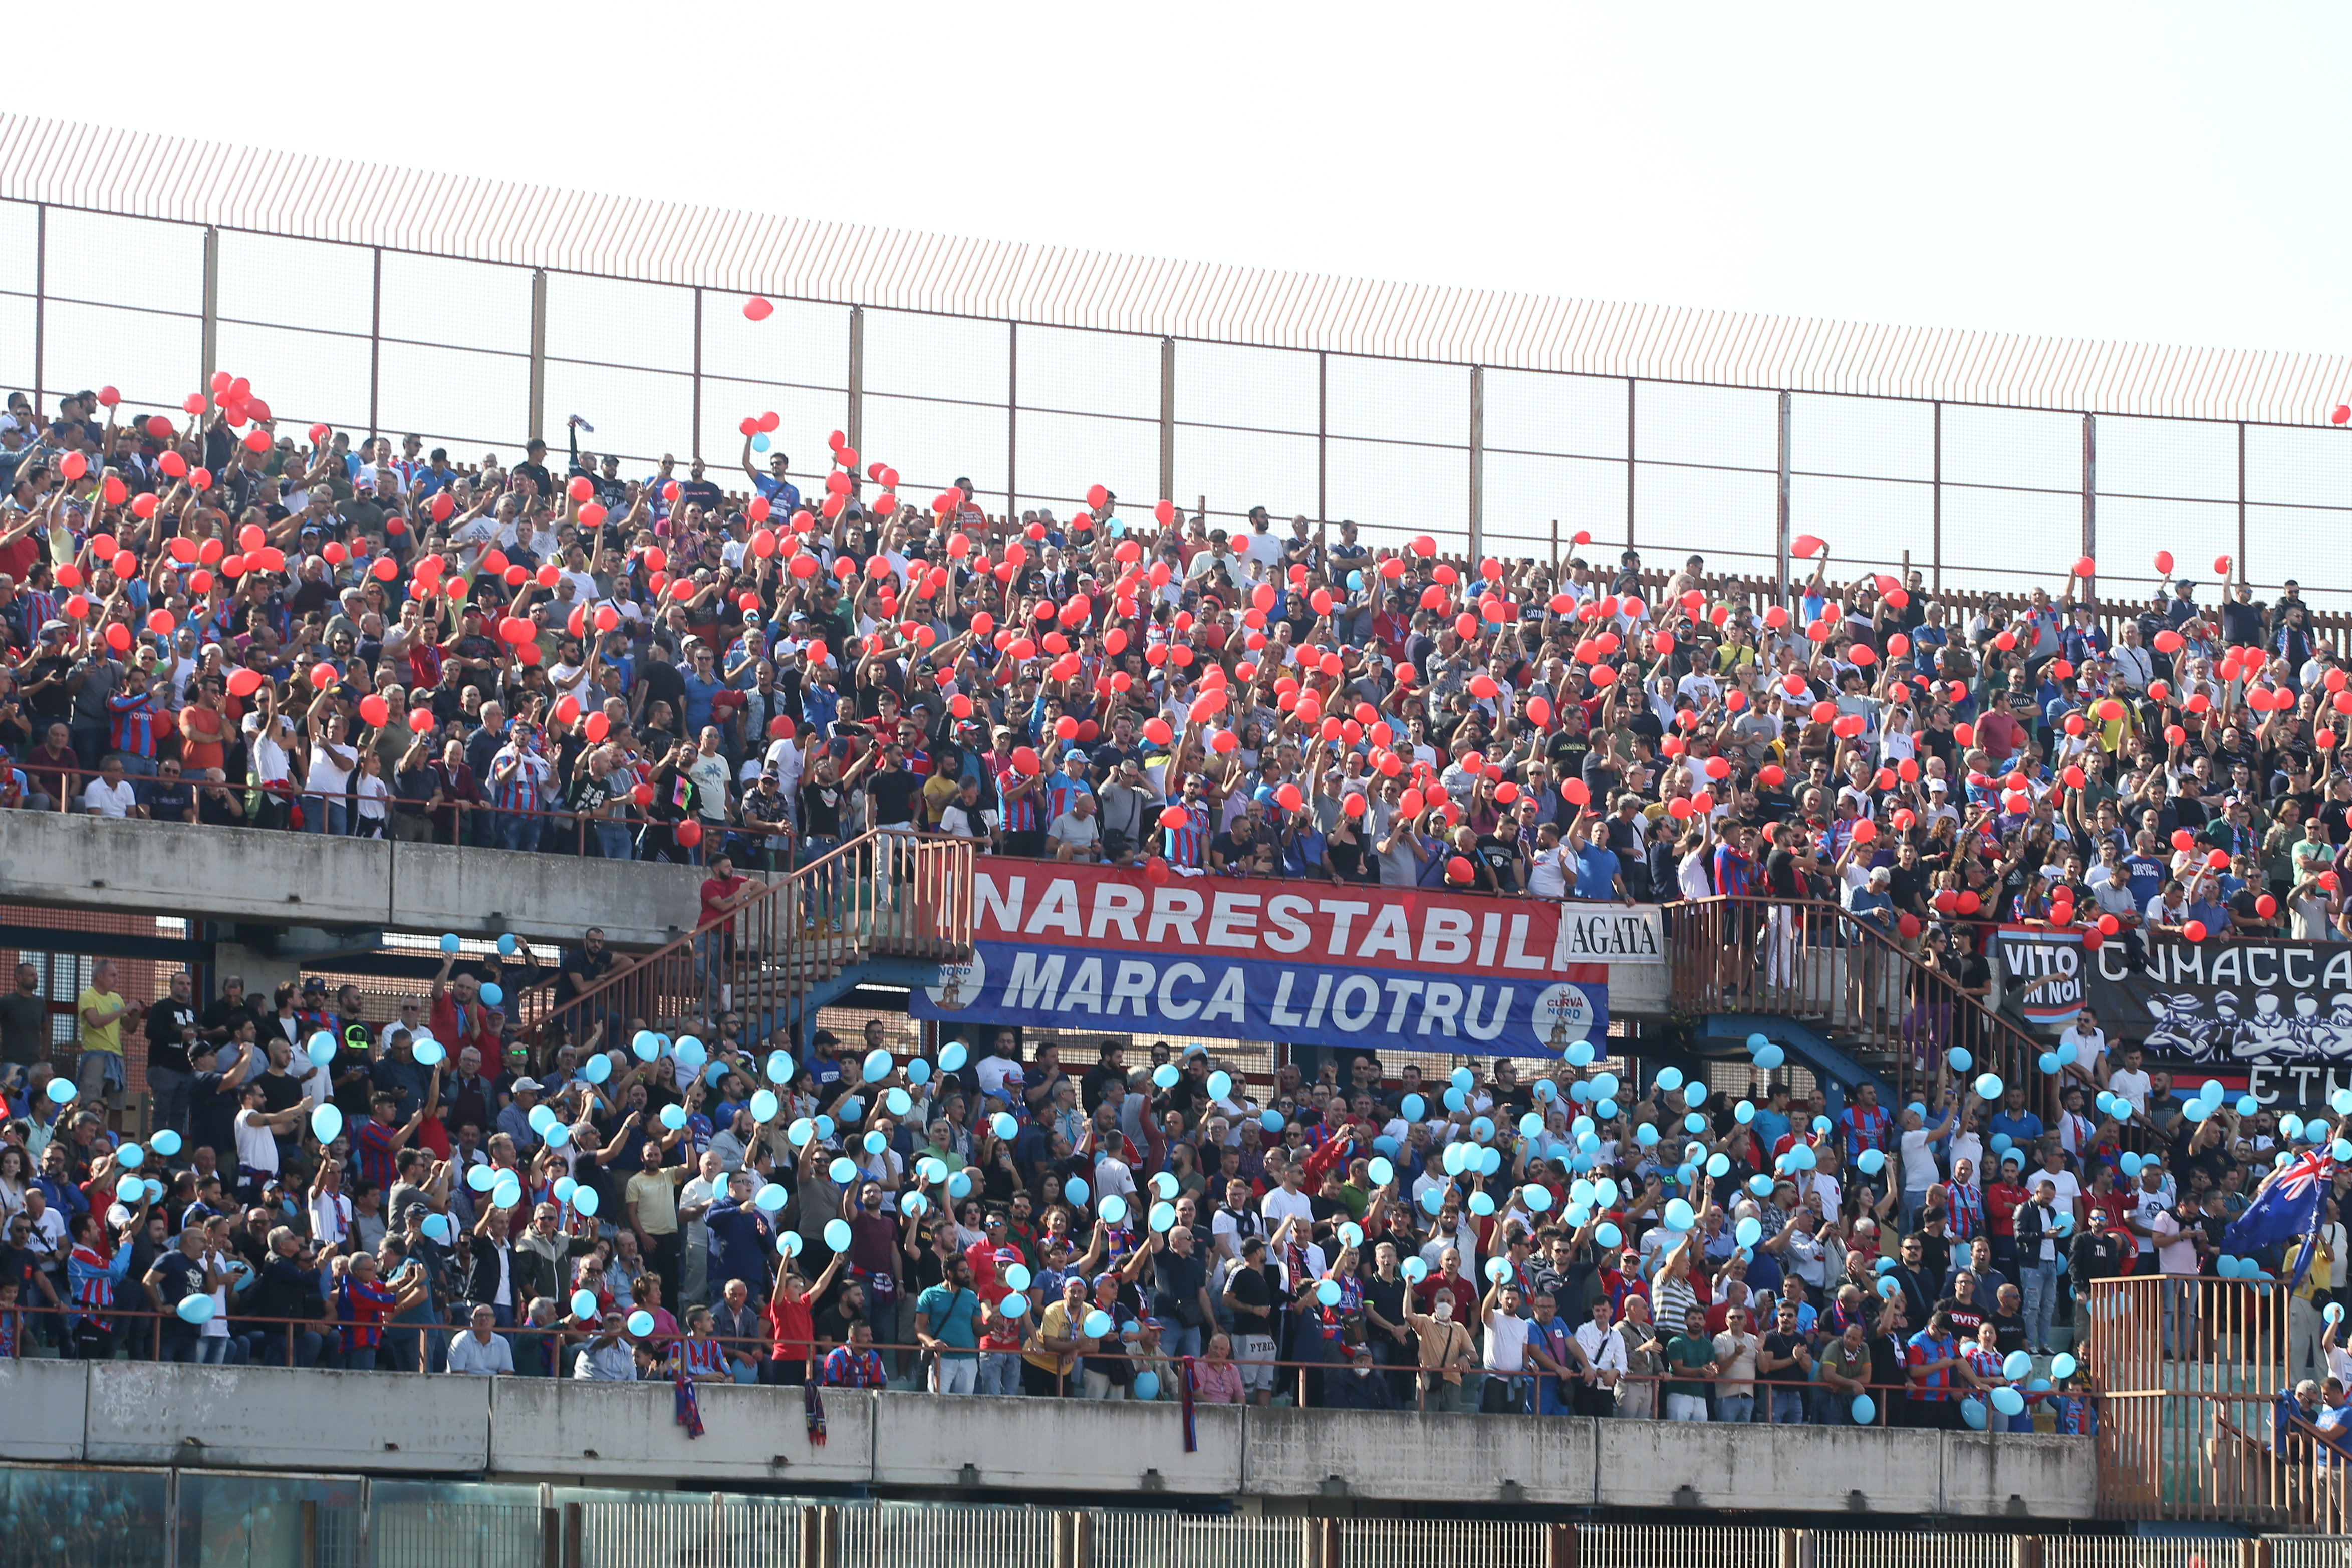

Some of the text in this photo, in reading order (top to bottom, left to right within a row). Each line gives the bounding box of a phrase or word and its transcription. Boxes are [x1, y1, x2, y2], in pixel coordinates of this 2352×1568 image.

[1526, 609, 1552, 619] CATAN
[129, 712, 152, 721] TOYOT
[1571, 915, 1658, 954] AGATA
[2004, 943, 2078, 977] VITO
[1001, 952, 1514, 1041] MARCA LIOTRU
[2048, 977, 2082, 1004] NOI
[1546, 996, 1583, 1008] CURVA
[1547, 1007, 1580, 1019] NORD
[27, 1236, 55, 1246] ARMNI
